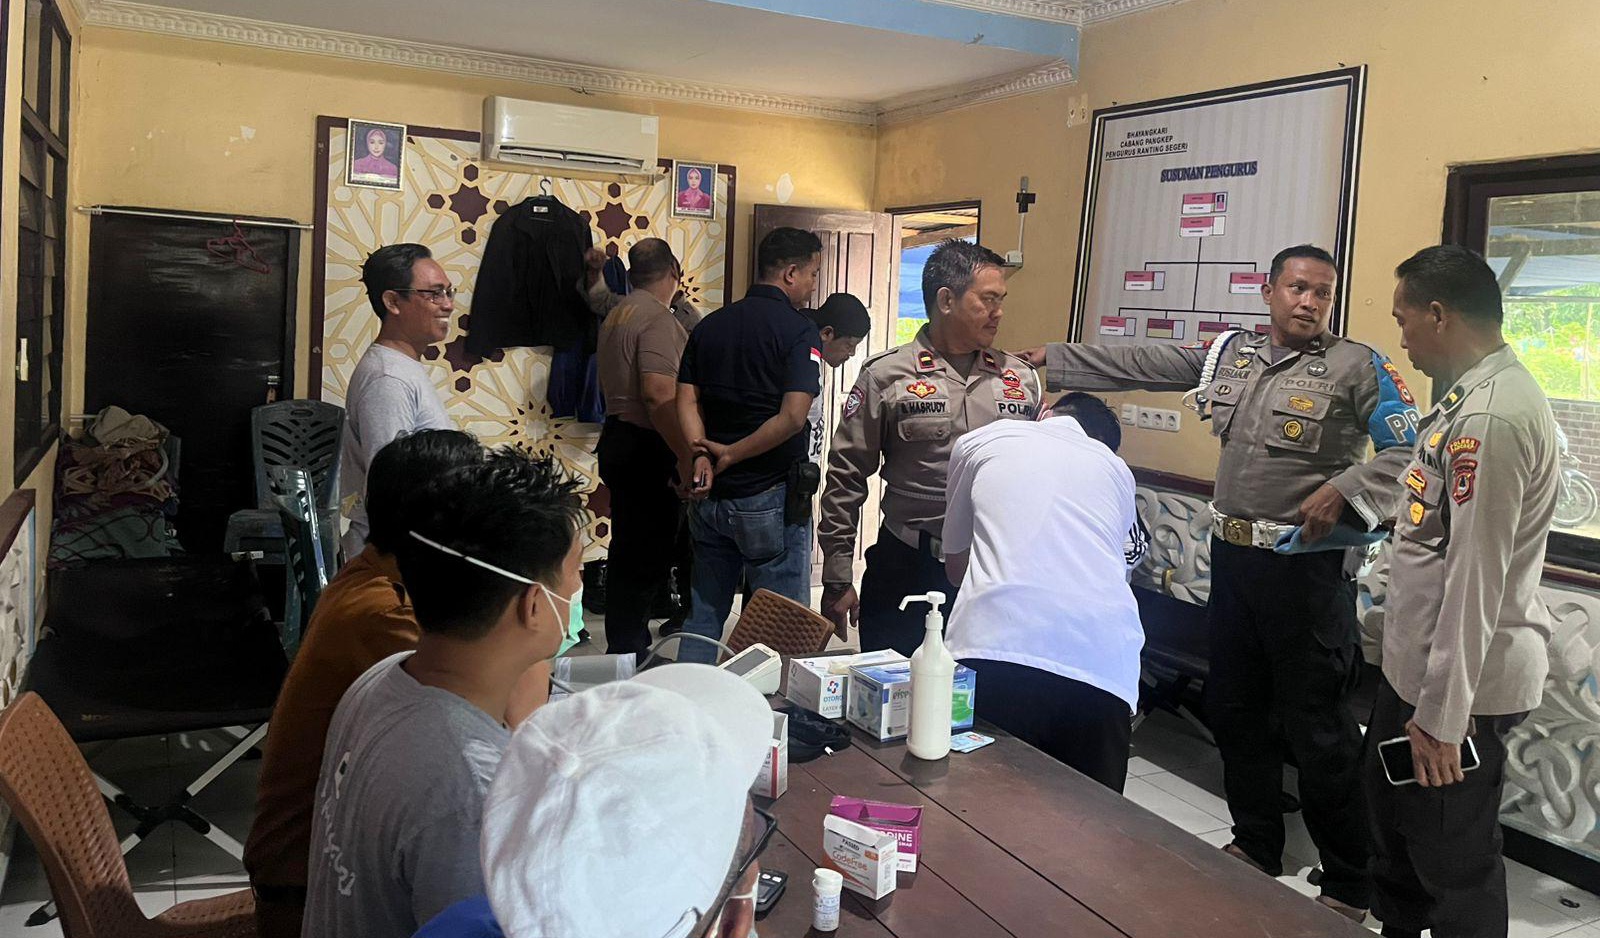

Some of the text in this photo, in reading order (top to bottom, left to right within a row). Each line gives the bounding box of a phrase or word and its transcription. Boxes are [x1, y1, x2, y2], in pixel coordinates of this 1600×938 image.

[1127, 127, 1168, 139] BHAYANGKARI
[1120, 135, 1174, 148] CABANG PANGKEP
[1105, 142, 1189, 158] PENGURUS RANTING SEGERI
[1160, 161, 1258, 183] SUSUNAN PENGURUS
[1285, 377, 1335, 392] POLRI
